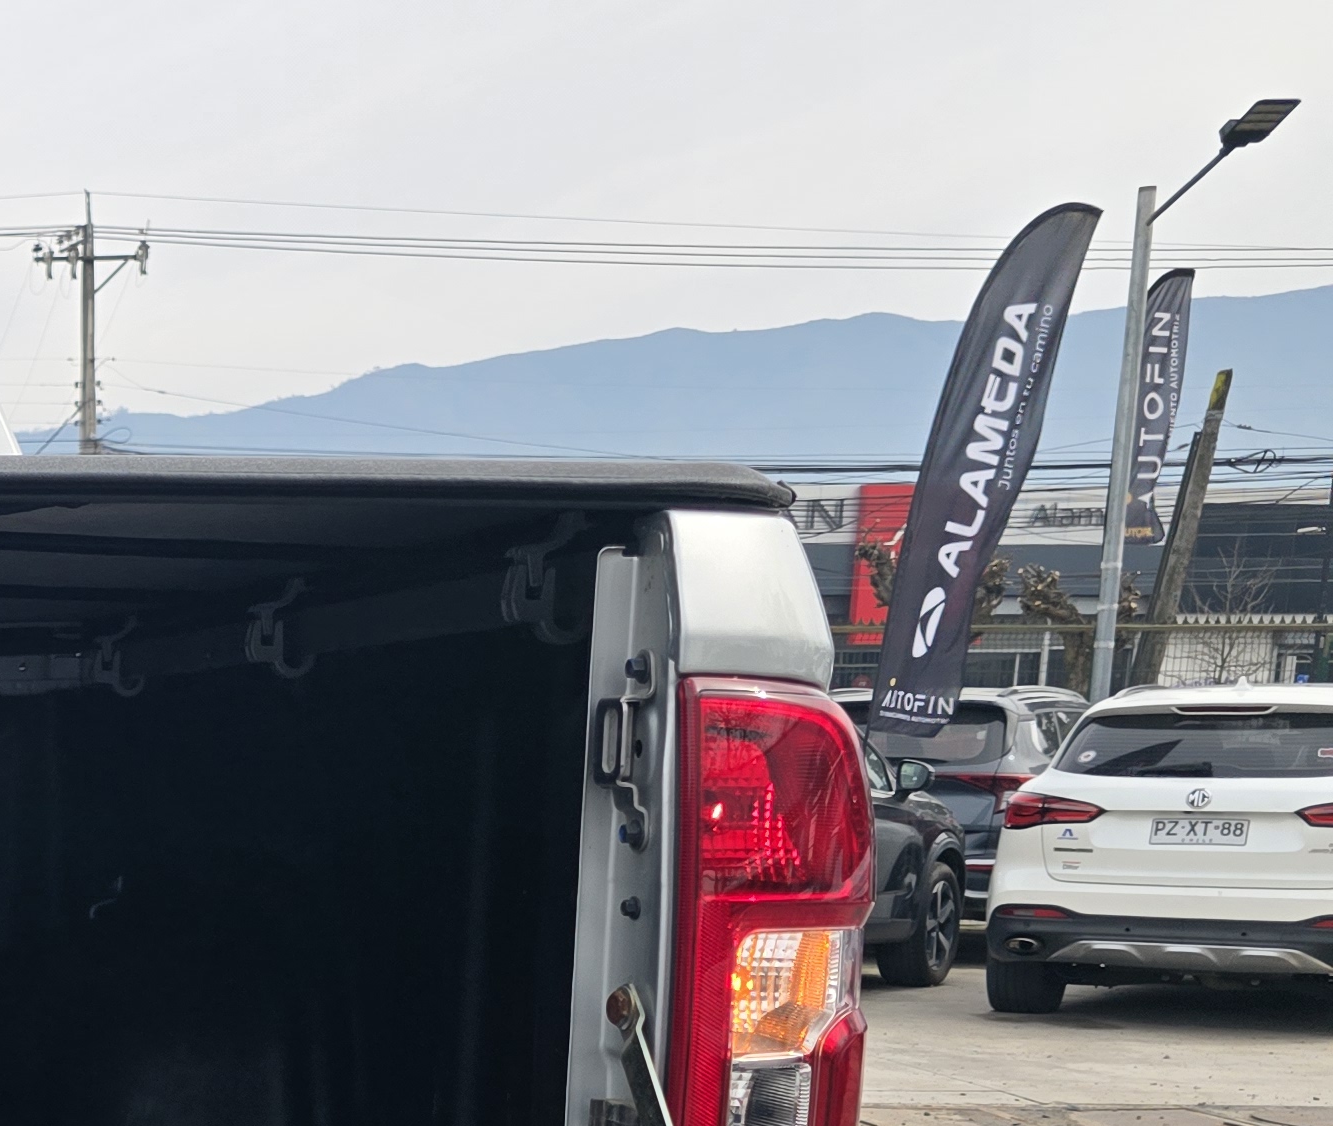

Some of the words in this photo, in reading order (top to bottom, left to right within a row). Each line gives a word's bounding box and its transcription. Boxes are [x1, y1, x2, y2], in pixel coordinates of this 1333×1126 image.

[938, 303, 1037, 578] ALAMEDA
[998, 430, 1019, 490] Juntos
[1015, 401, 1026, 424] en
[1031, 303, 1054, 374] camino
[1188, 789, 1211, 807] MG
